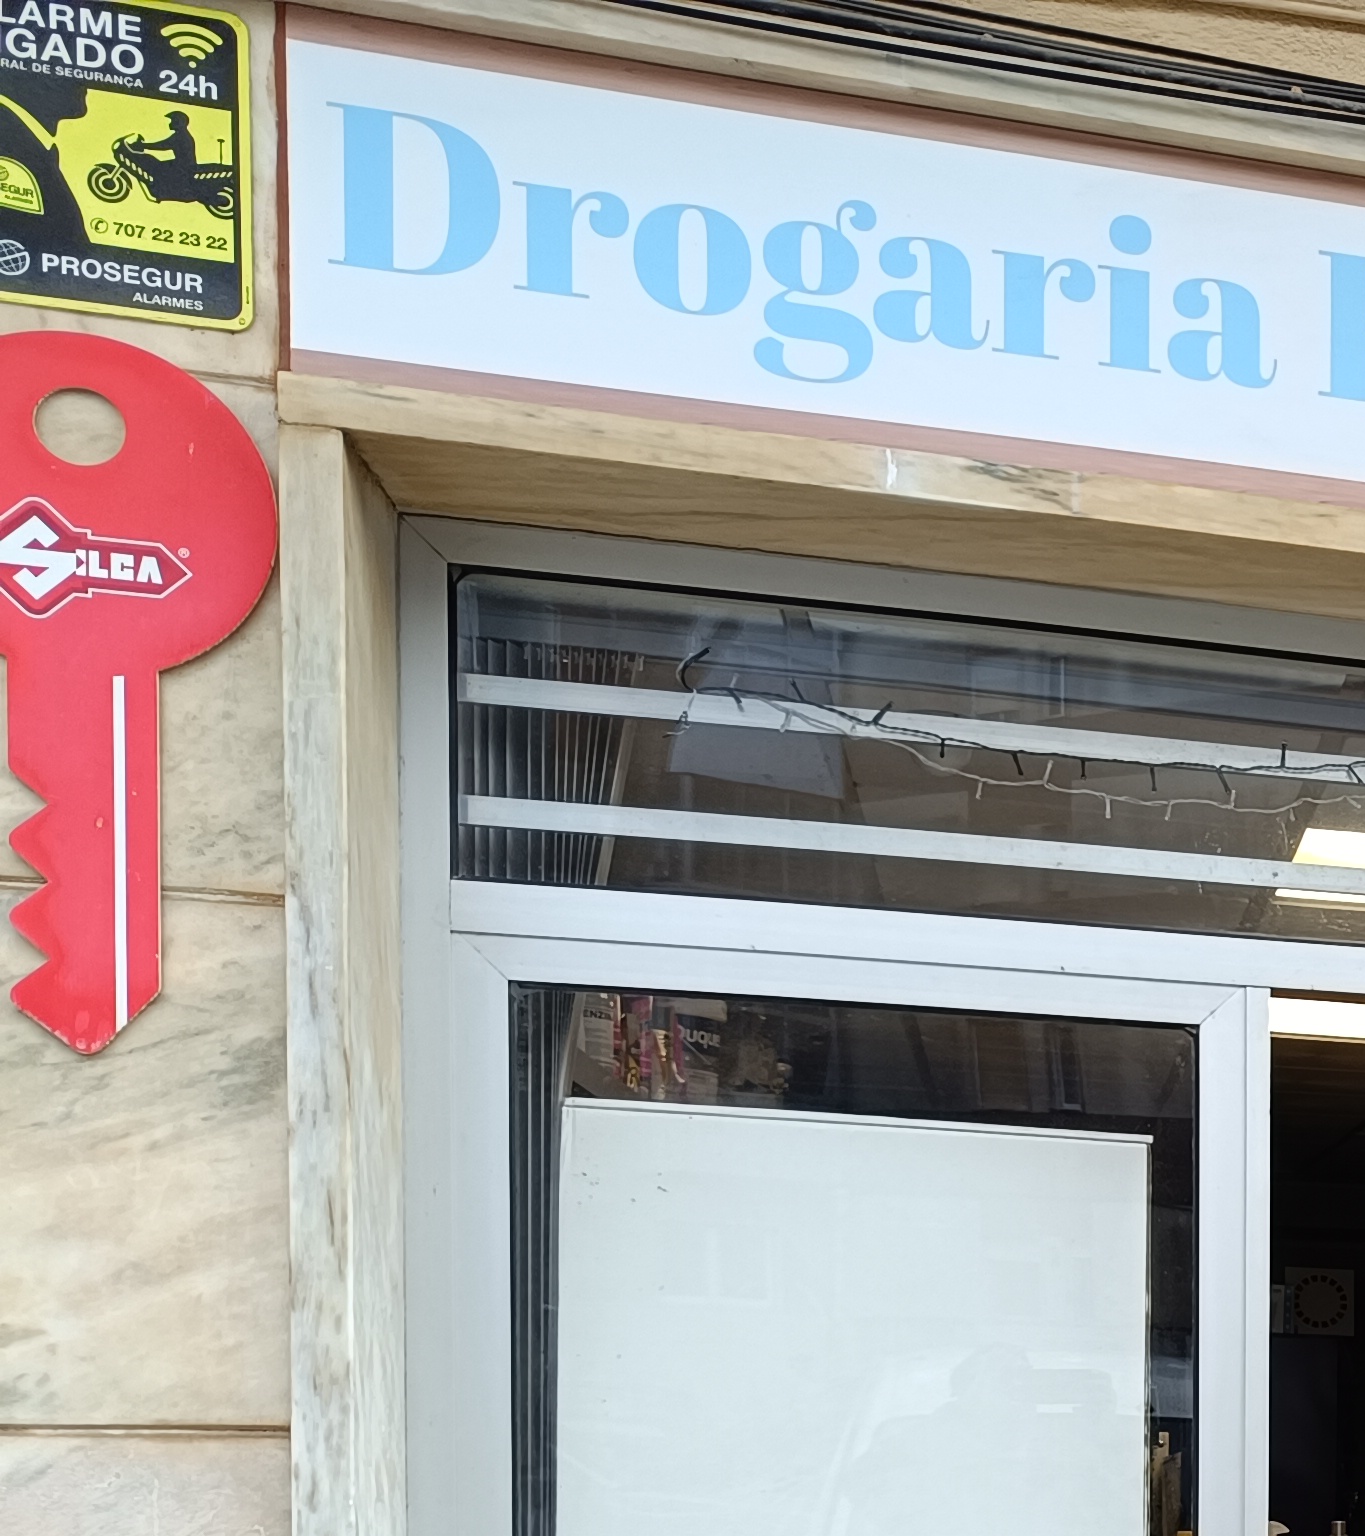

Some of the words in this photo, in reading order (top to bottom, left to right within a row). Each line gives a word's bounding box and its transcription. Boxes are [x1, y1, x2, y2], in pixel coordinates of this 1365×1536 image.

[31, 62, 52, 75] DE
[55, 65, 144, 88] SEGURANÇA
[158, 69, 218, 100] 24h
[113, 222, 145, 239] 707
[152, 227, 174, 244] 22
[179, 231, 200, 247] 23
[206, 235, 228, 252] 22
[325, 100, 1278, 390] Drogaria
[41, 252, 204, 294] PROSEGUR
[132, 292, 204, 311] ALARMES
